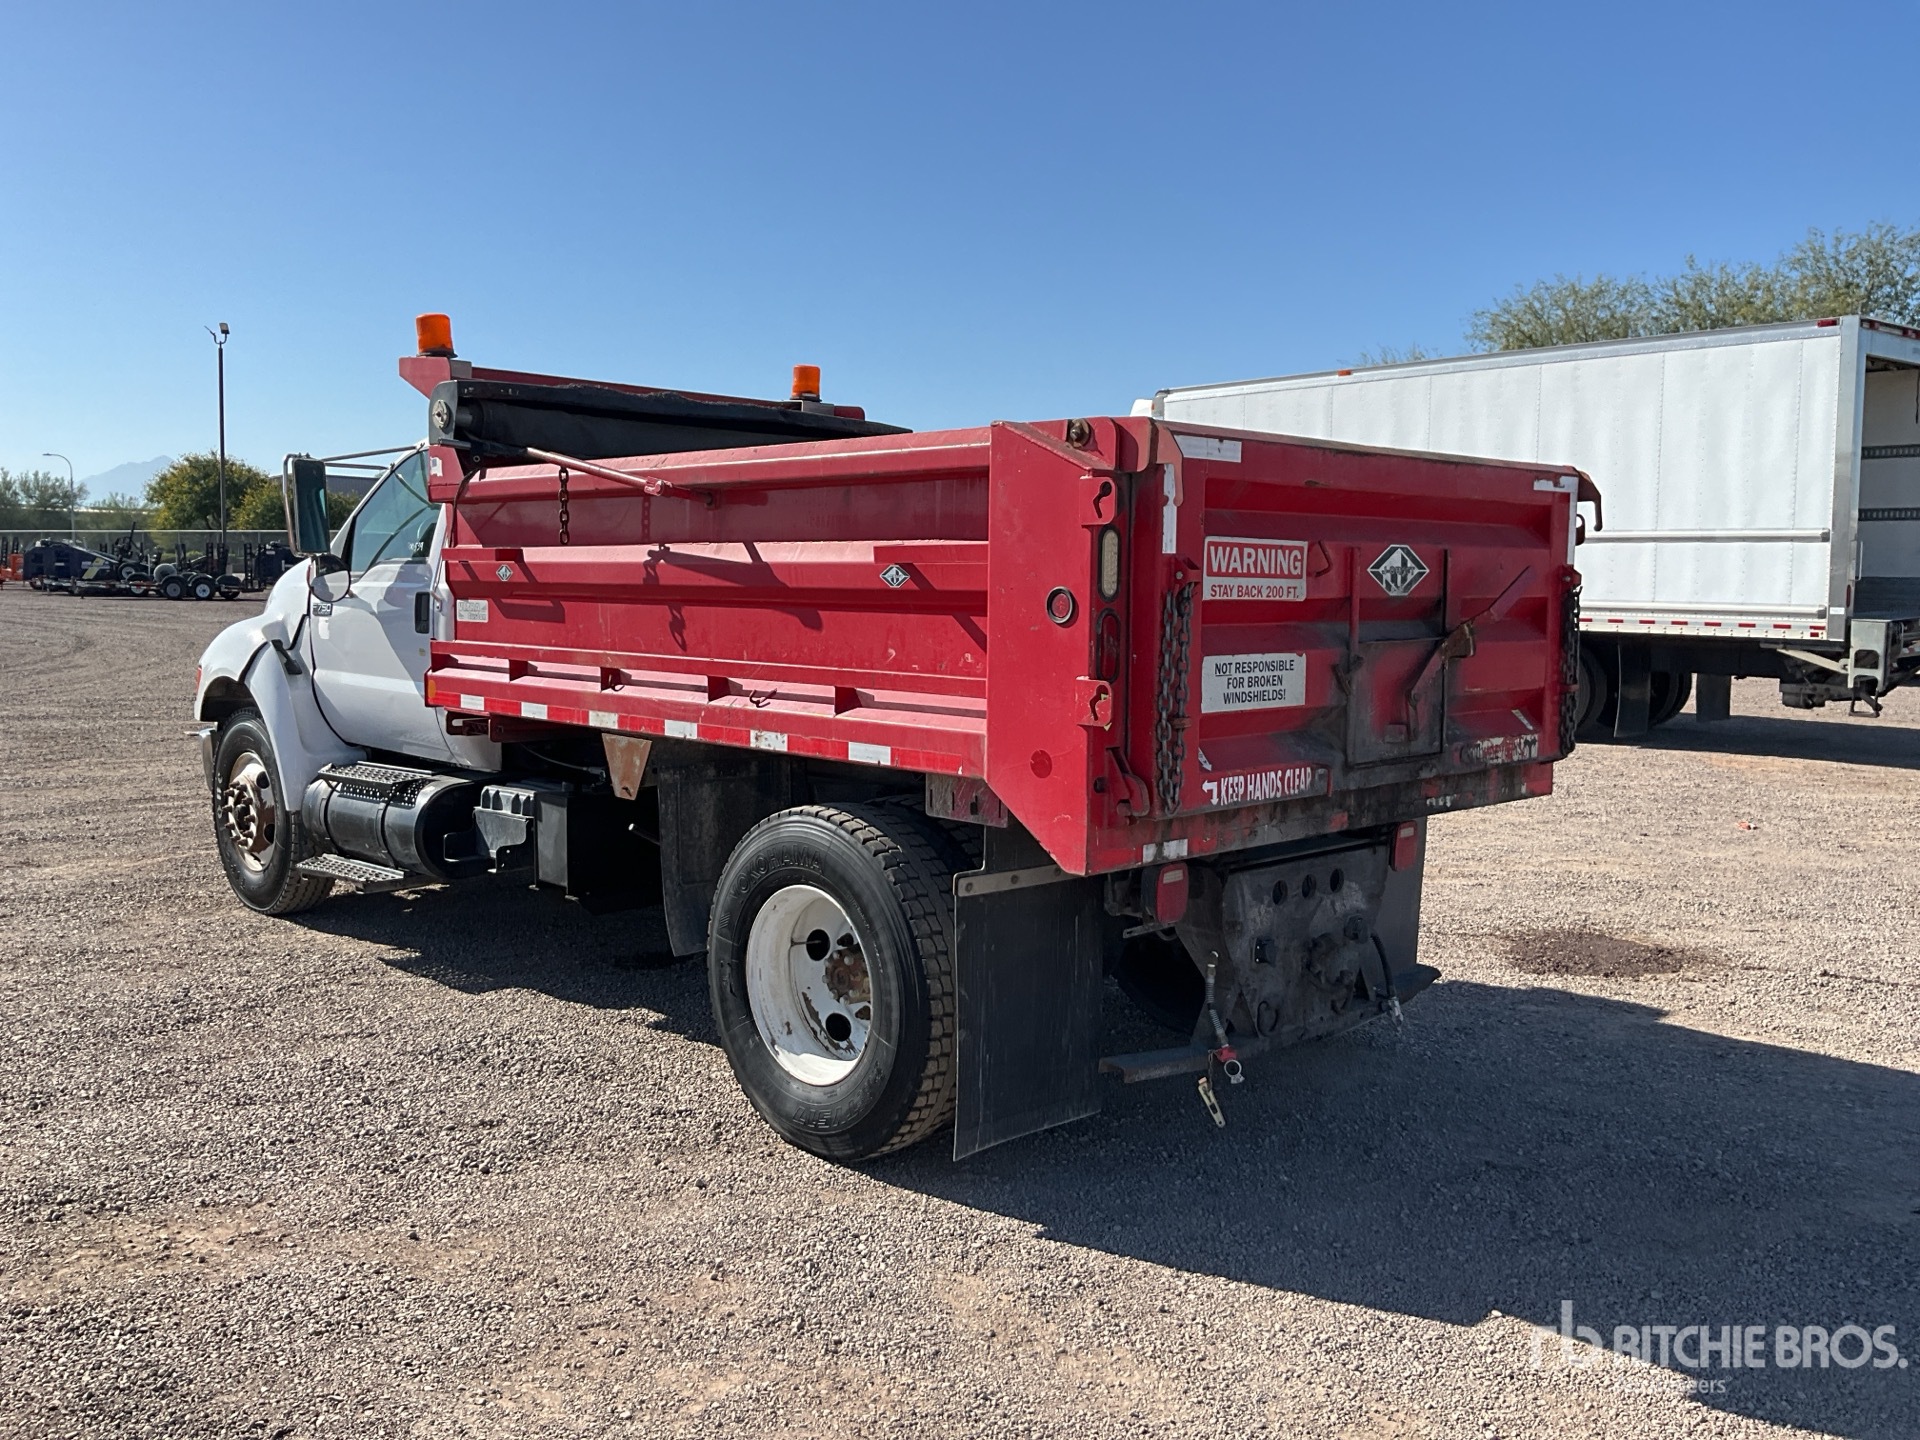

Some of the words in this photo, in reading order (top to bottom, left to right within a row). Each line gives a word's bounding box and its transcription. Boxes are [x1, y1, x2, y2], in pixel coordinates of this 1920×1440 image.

[1210, 546, 1302, 576] WARNING
[1210, 584, 1235, 598] STAY
[1237, 585, 1263, 598] BACK
[1266, 585, 1284, 598] 200
[1286, 586, 1300, 599] FT.
[1214, 662, 1233, 676] NOT
[1234, 659, 1295, 674] RESPONSIBLE
[1227, 676, 1245, 689] FOR
[1247, 674, 1283, 688] BROKEN
[1223, 688, 1287, 705] WINDSHIELDS!
[1220, 775, 1245, 806] KEEP
[1247, 769, 1283, 801] HANDS
[729, 843, 825, 899] YOKOHAMA
